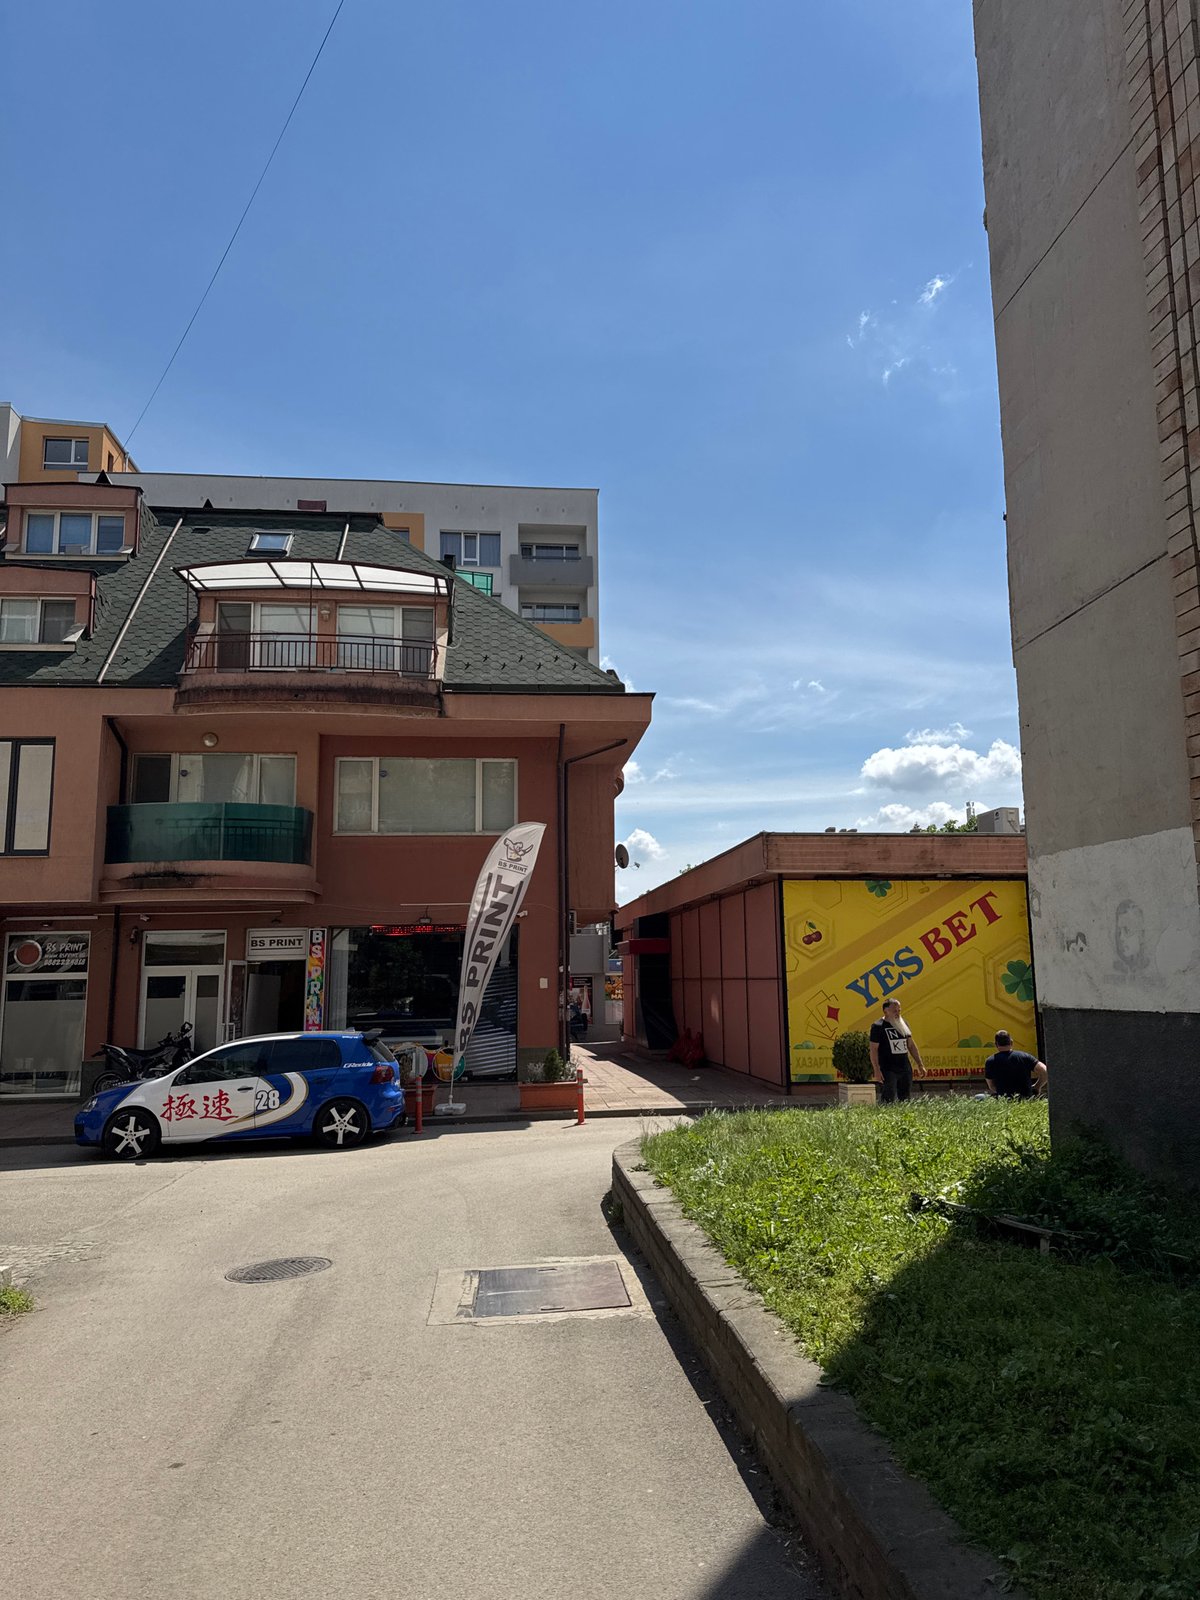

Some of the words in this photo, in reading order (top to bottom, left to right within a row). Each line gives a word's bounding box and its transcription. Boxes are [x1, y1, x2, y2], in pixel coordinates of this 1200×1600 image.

[498, 860, 508, 868] BS
[509, 863, 528, 873] PRINT
[466, 873, 515, 988] PRINT
[45, 942, 57, 954] BS
[60, 942, 86, 953] PRINT
[251, 939, 266, 948] BS
[269, 938, 303, 948] PRINT
[311, 930, 323, 958] BS
[845, 945, 924, 1008] YES
[919, 890, 1003, 963] BET
[795, 1056, 832, 1068] ХАЗАРТ
[160, 1088, 239, 1122] 極速
[255, 1090, 280, 1111] 28
